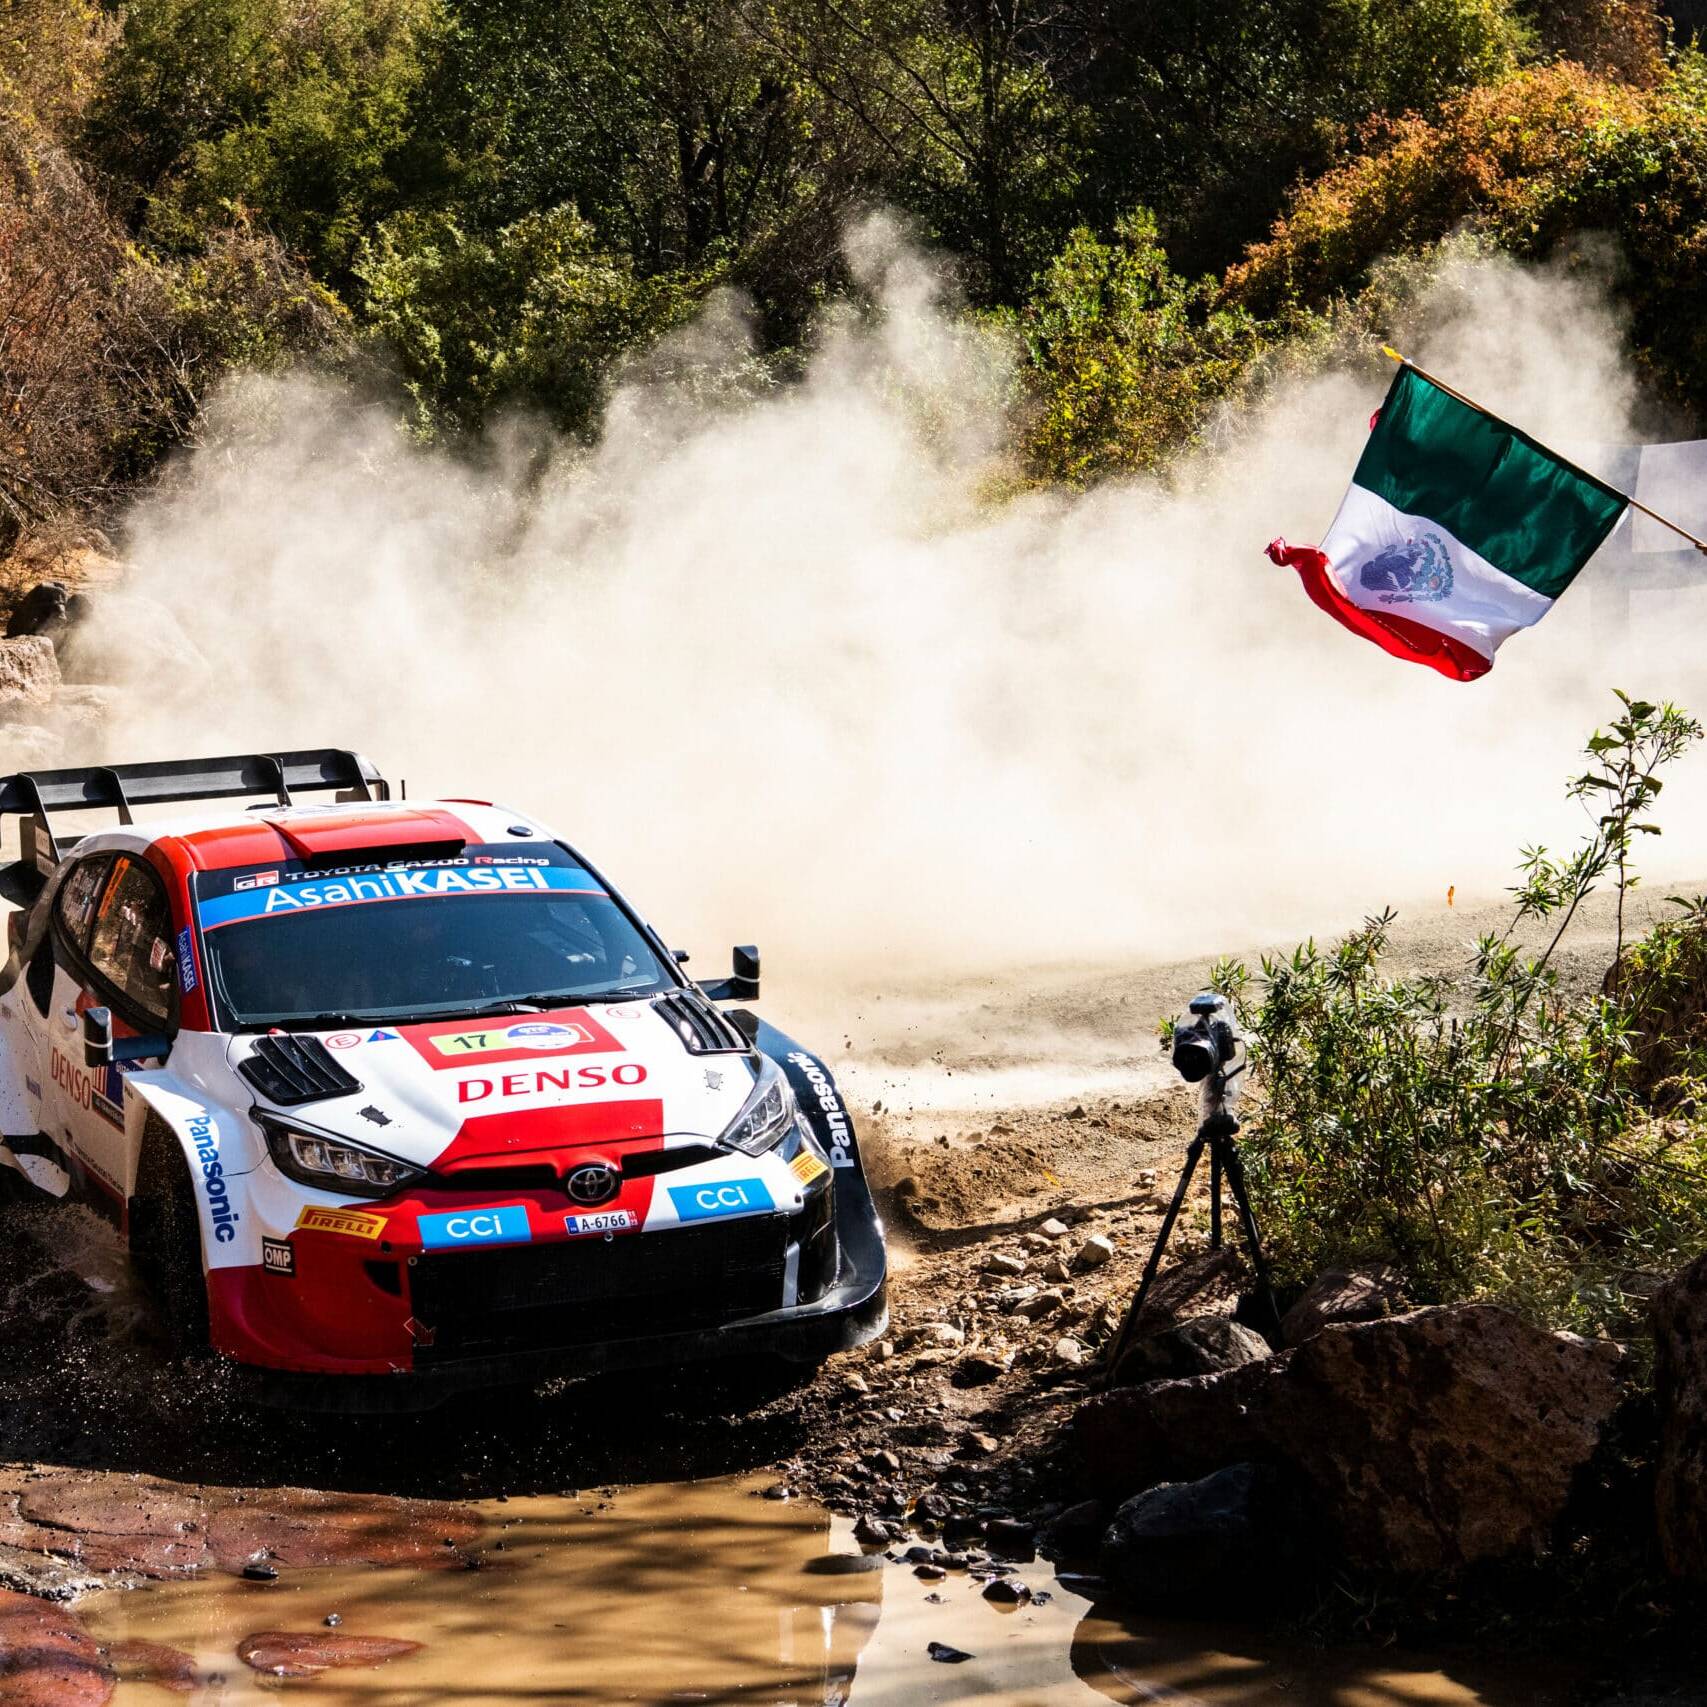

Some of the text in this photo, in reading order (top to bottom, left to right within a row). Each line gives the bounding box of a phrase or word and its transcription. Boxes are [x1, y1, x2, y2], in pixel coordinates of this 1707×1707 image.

[236, 875, 277, 890] GR
[285, 864, 381, 880] TOYOTA
[474, 856, 550, 866] Racing
[453, 1034, 487, 1049] 17
[51, 1047, 91, 1111] DENSO
[457, 1064, 648, 1103] DENSO
[787, 1052, 855, 1168] Panasonic
[185, 1113, 239, 1243] Panasonic
[301, 1209, 379, 1234] PIRELLI
[582, 1214, 626, 1230] A-6766
[264, 1247, 291, 1267] OMP
